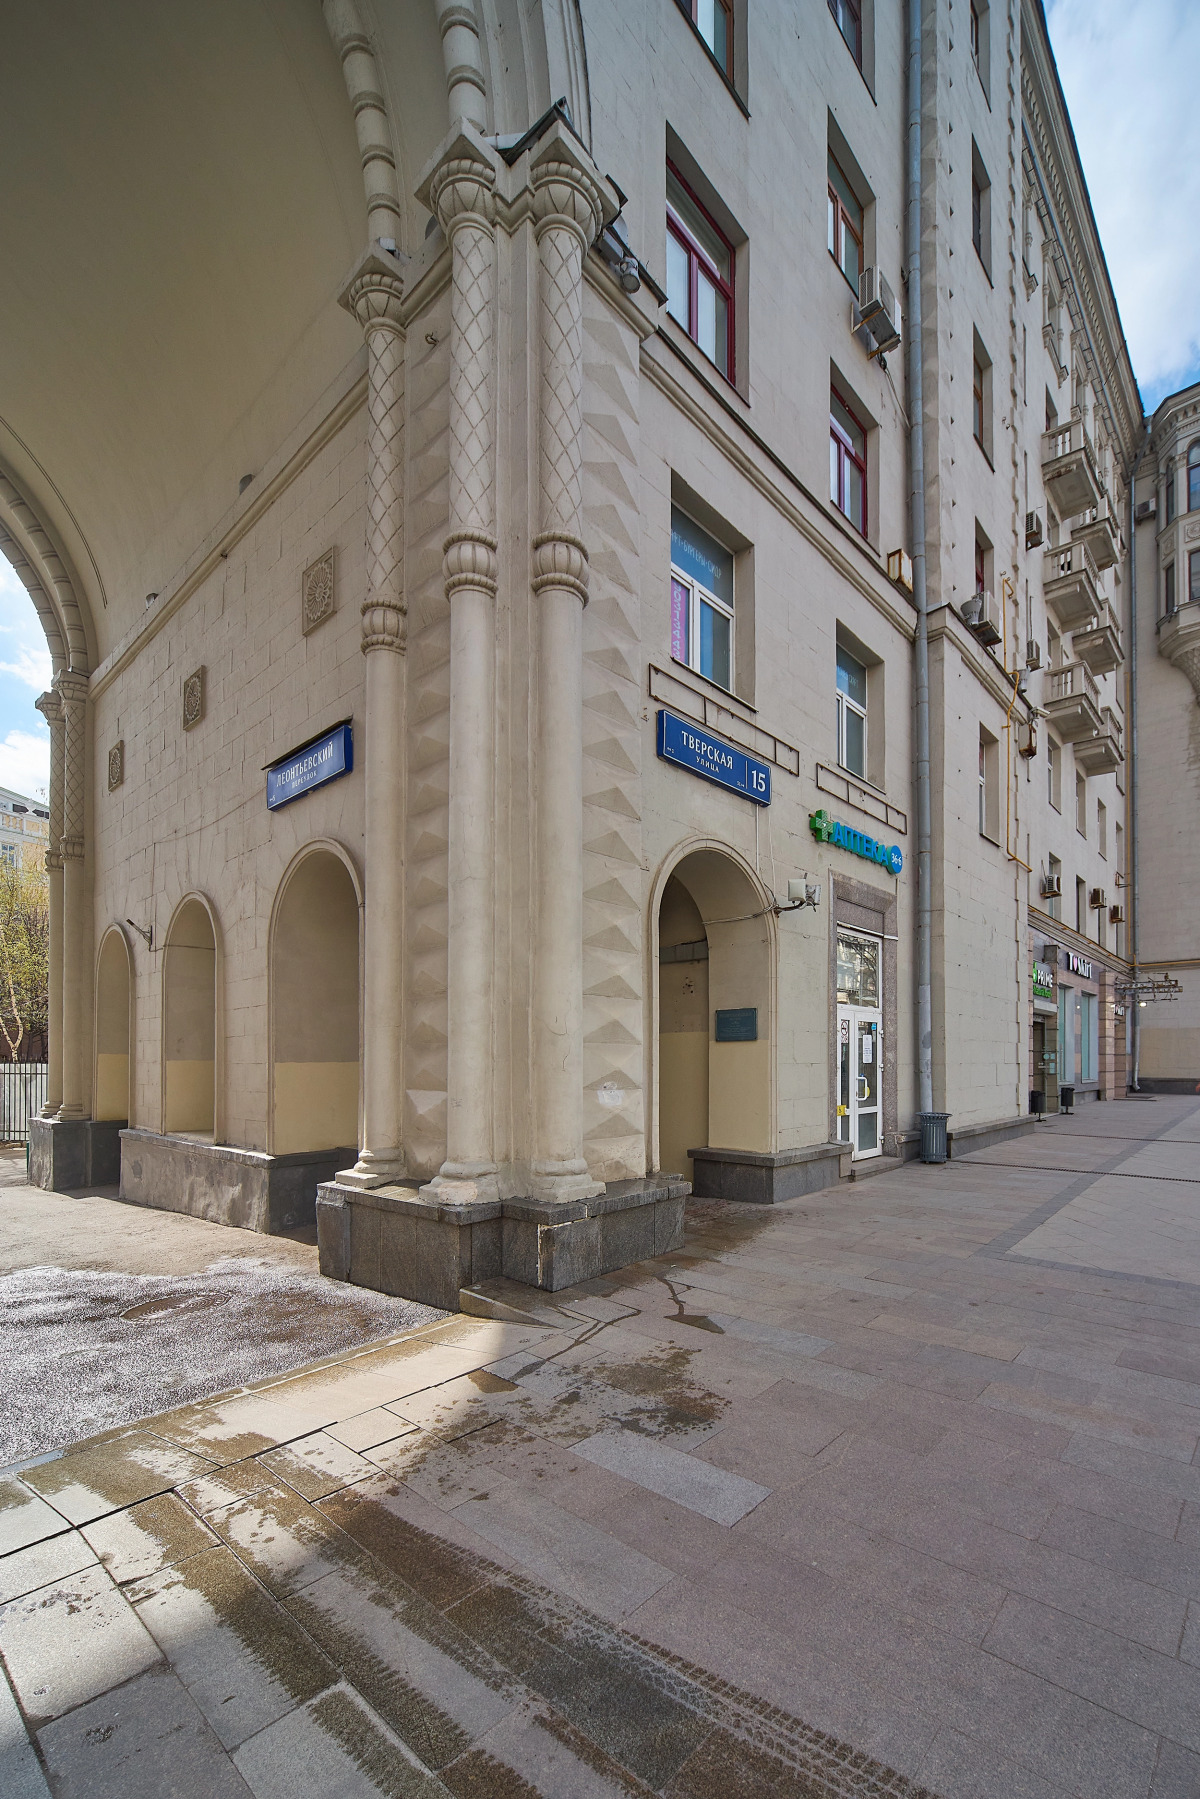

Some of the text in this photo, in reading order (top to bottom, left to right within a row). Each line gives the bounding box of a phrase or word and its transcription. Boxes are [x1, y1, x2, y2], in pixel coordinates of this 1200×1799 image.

[276, 741, 334, 787] ЛЕОНТЬЕВСКИЙ
[681, 730, 766, 792] ТВЕРСКАЯ 15
[695, 755, 720, 773] УЛИЦА
[291, 770, 317, 789] ПЕРЕУЛОК
[833, 821, 889, 866] АПТЕКА
[1037, 969, 1053, 988] PRIME
